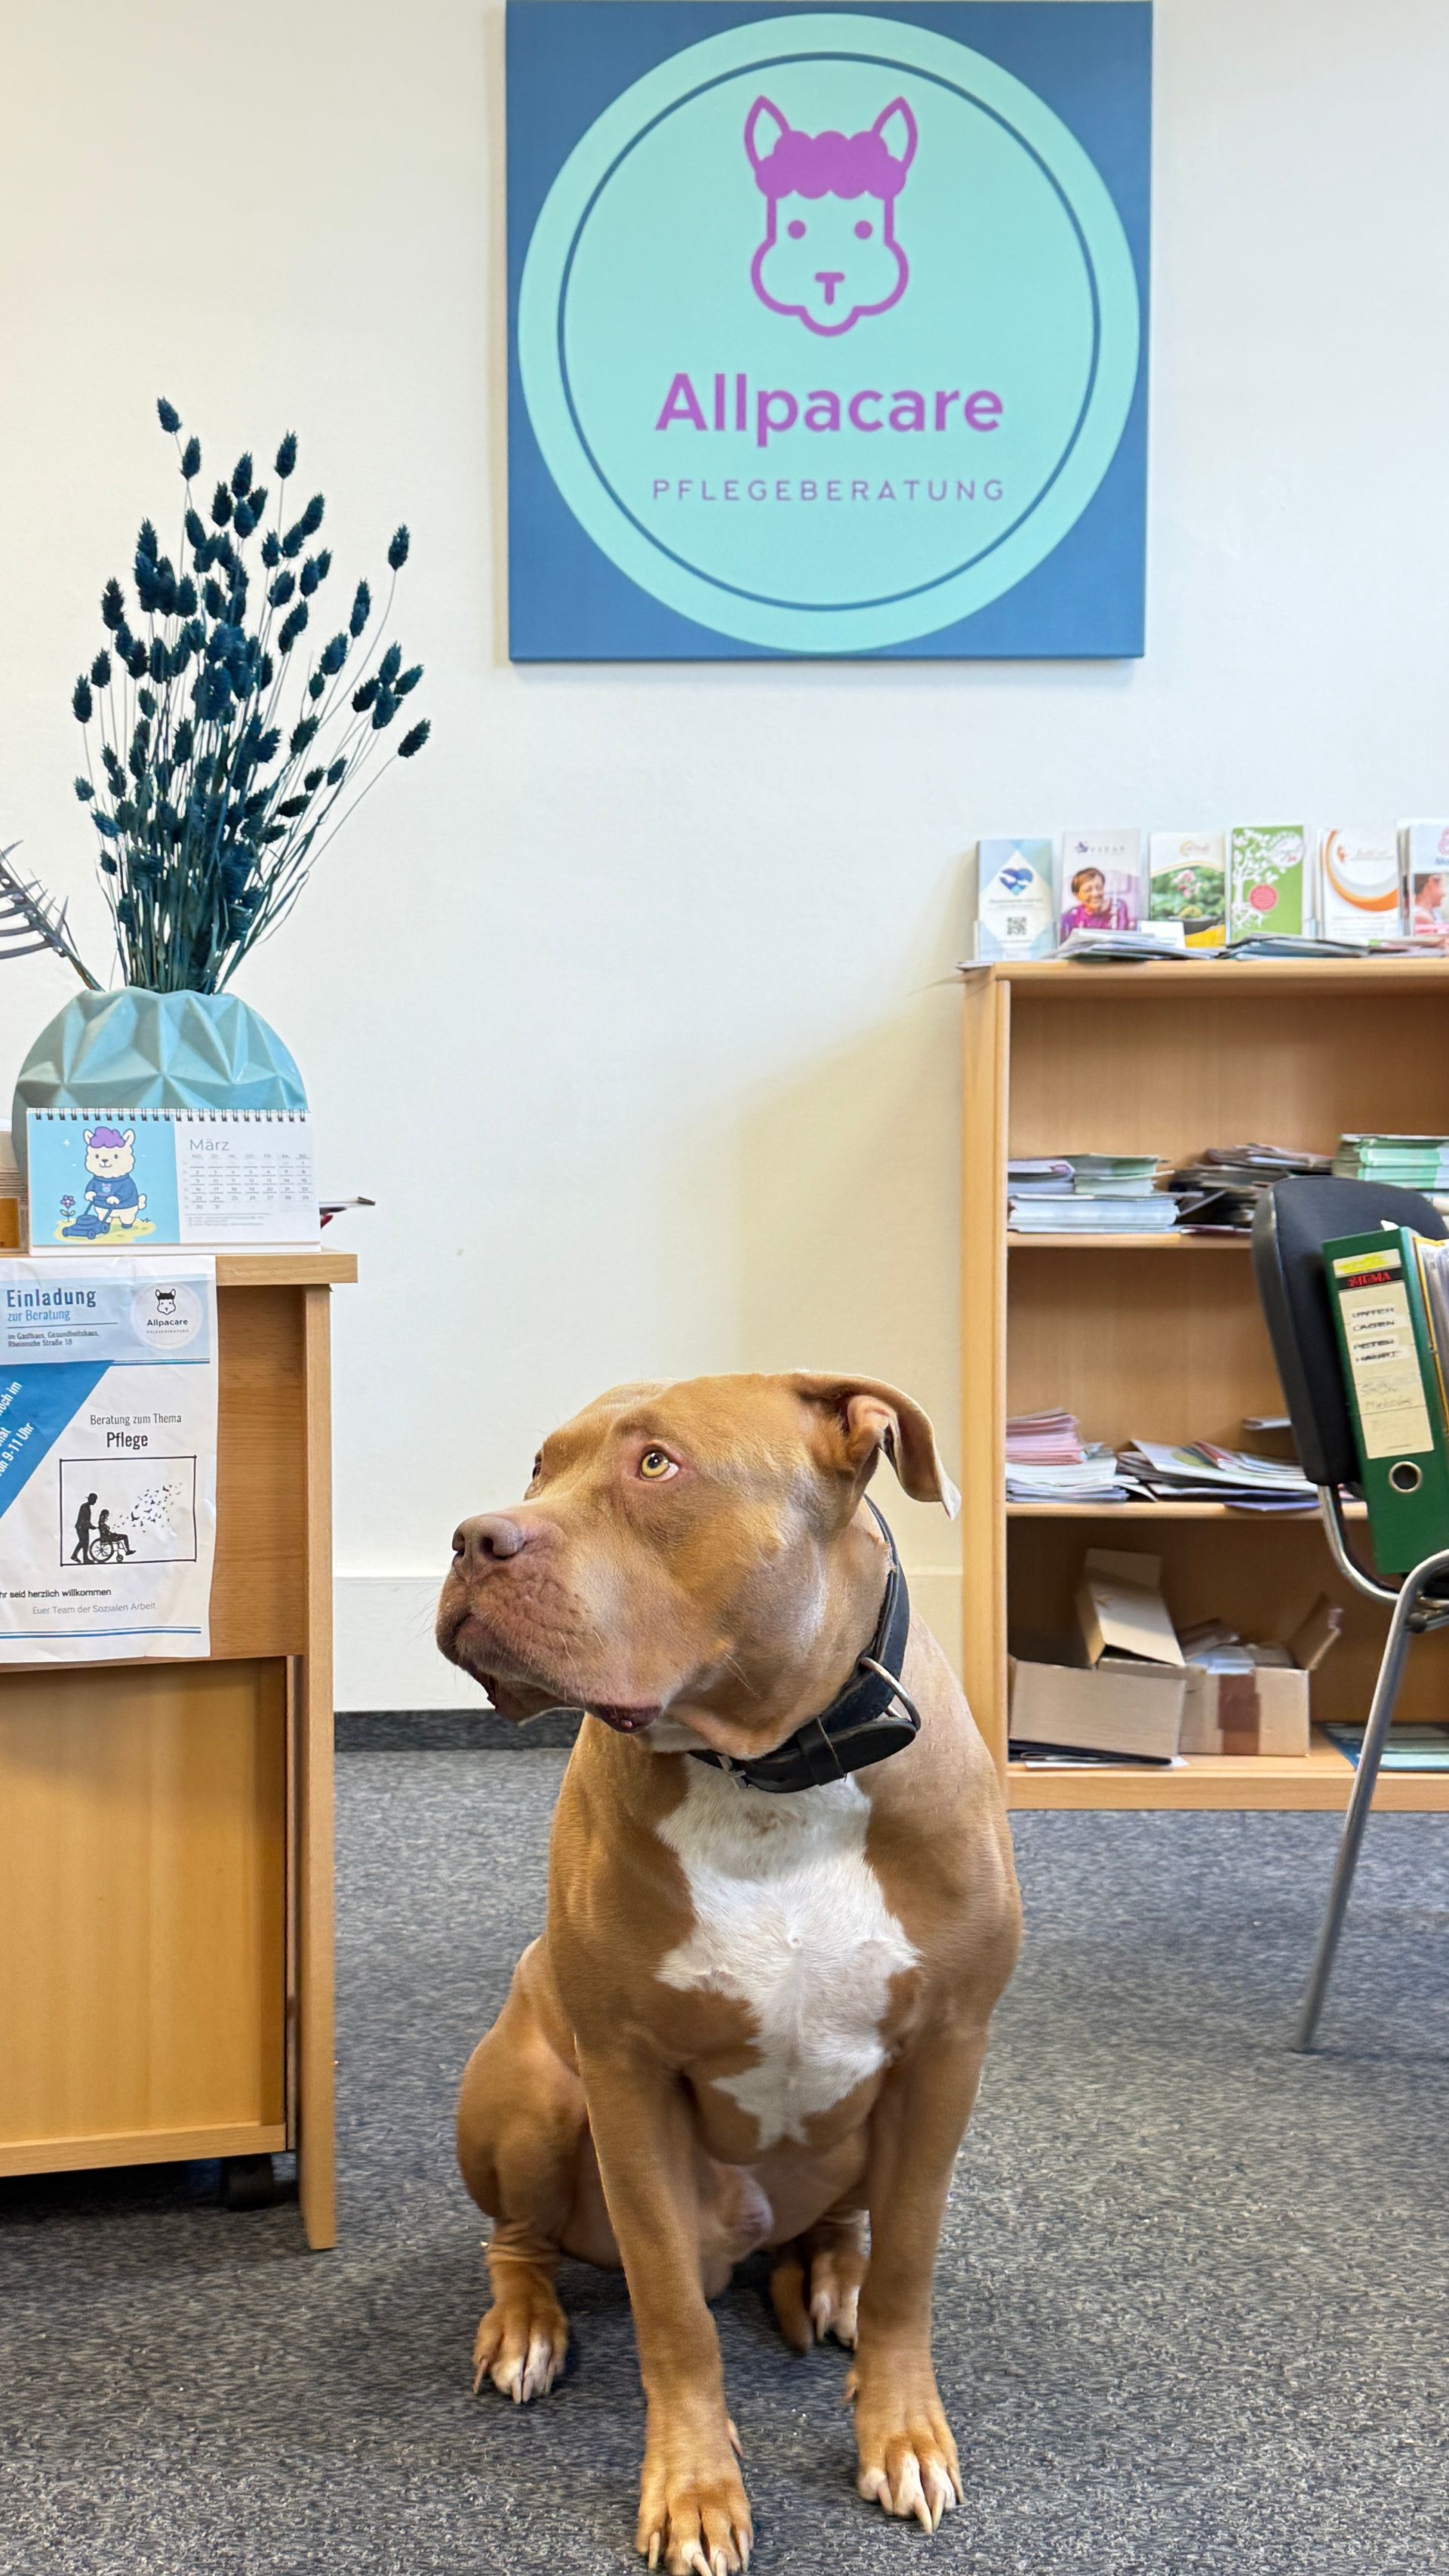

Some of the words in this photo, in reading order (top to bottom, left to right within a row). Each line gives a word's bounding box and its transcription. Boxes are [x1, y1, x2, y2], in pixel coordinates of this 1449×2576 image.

[654, 373, 1004, 448] Allpacare
[653, 479, 1004, 501] PFLEGEBERATUNG
[189, 1138, 230, 1151] März
[6, 1288, 97, 1308] Einladung
[8, 1313, 23, 1322] zur
[26, 1310, 71, 1321] Beratung
[146, 1319, 189, 1328] Allpacare
[6, 1381, 23, 1395] im
[90, 1414, 131, 1426] Beratung
[133, 1415, 151, 1424] zum
[152, 1413, 182, 1423] Thema
[0, 1426, 11, 1447] nat
[2, 1438, 23, 1462] 9-11
[16, 1422, 34, 1440] Uhr
[106, 1431, 149, 1450] Pflege
[9, 1590, 26, 1599] seid
[28, 1589, 60, 1598] herzlich
[62, 1588, 112, 1597] willkommen
[32, 1606, 51, 1614] Euer
[52, 1605, 75, 1614] Team
[77, 1605, 91, 1613] der
[92, 1604, 129, 1613] Sozialen
[131, 1602, 156, 1610] Arbeit
